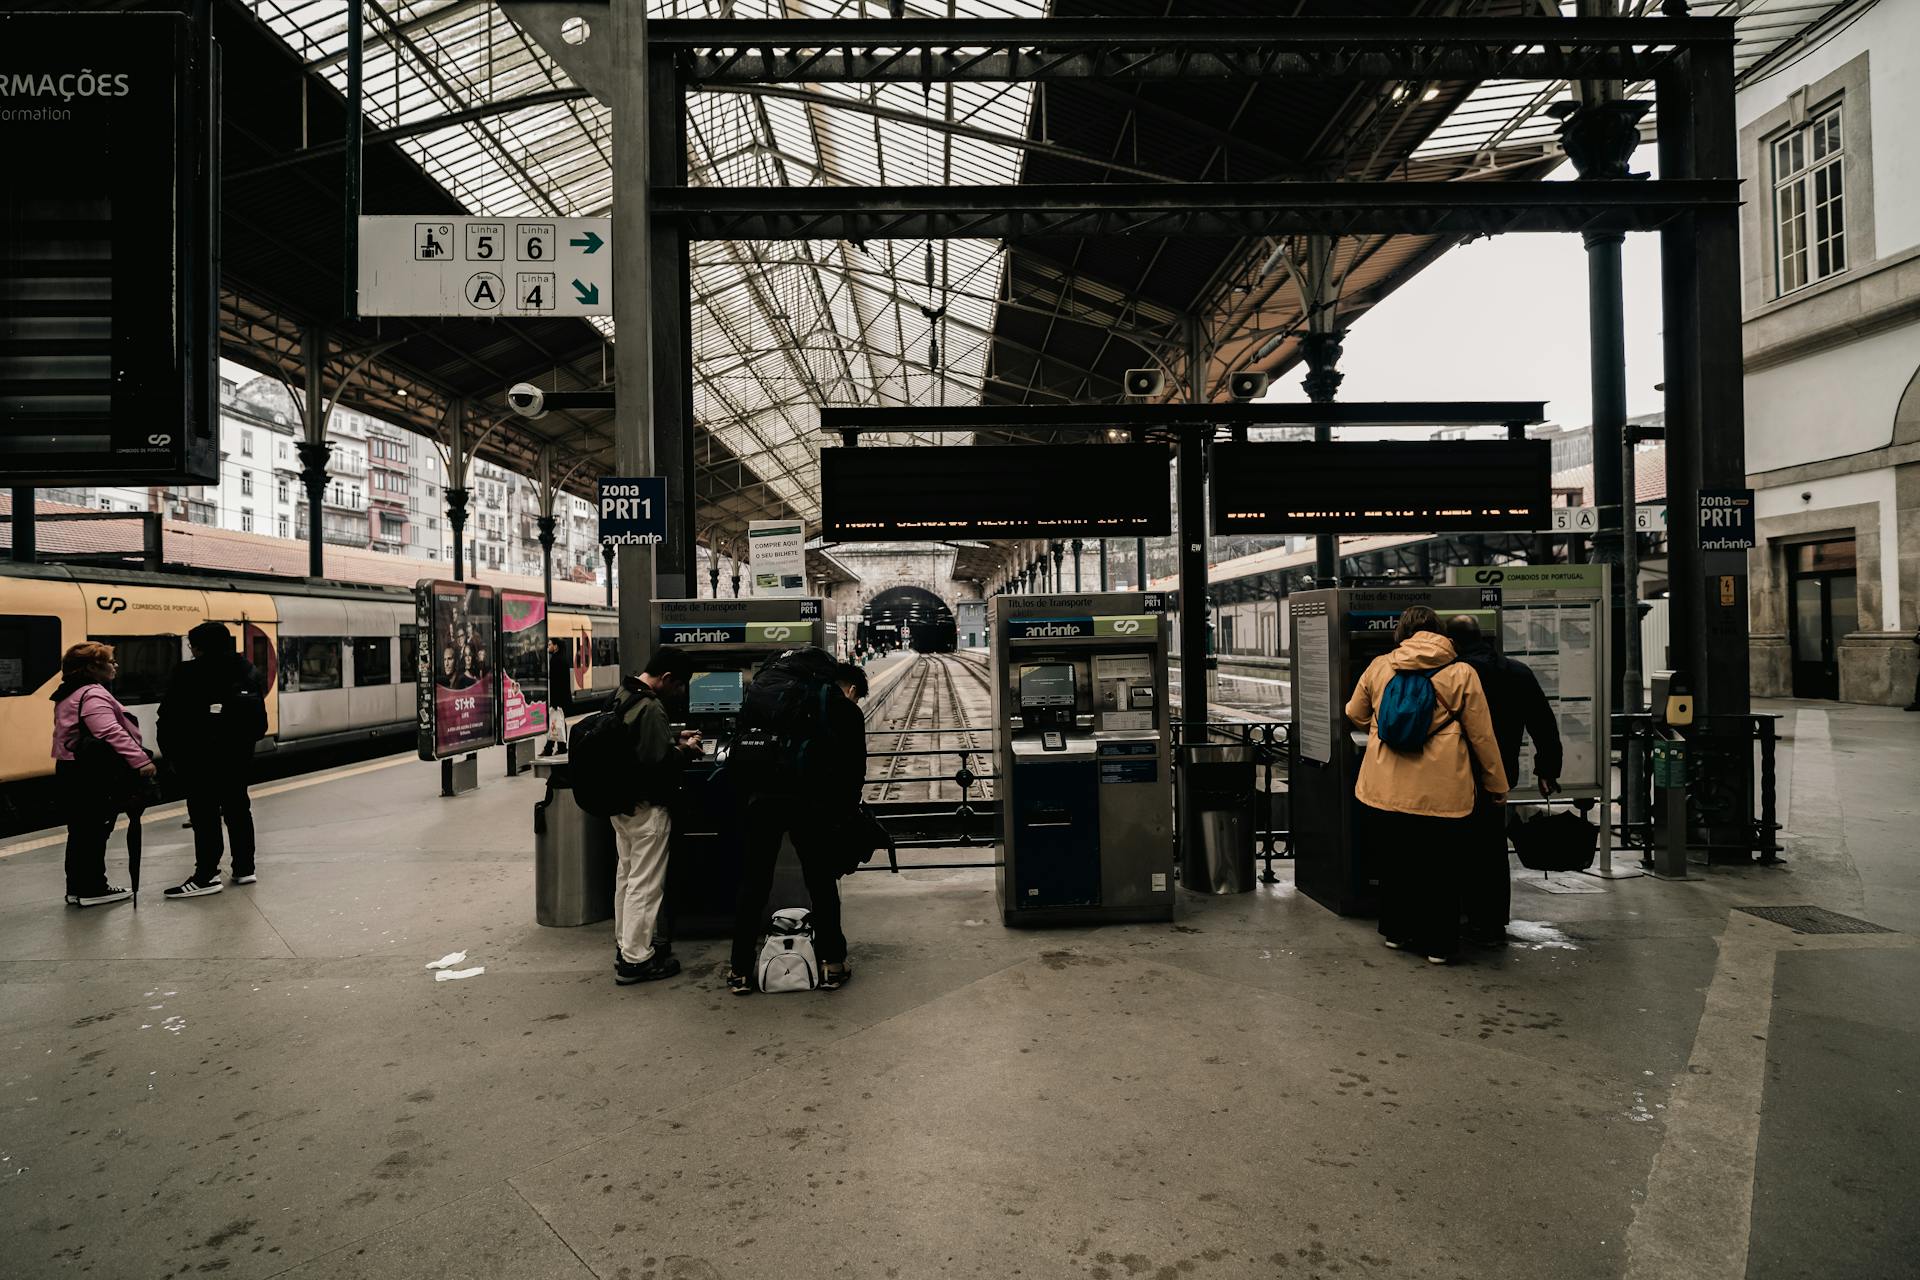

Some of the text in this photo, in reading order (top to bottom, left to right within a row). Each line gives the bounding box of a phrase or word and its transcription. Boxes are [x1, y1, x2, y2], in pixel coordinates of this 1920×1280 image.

[471, 226, 498, 234] Linha
[522, 226, 549, 235] Linha
[477, 236, 493, 259] 5
[527, 237, 543, 259] 6
[522, 275, 549, 283] Linha
[473, 280, 496, 303] A
[526, 285, 543, 308] 4
[601, 485, 640, 497] zona
[1700, 496, 1731, 507] zona
[602, 498, 651, 520] PRT1
[1558, 516, 1566, 528] 5
[1580, 514, 1591, 526] A
[1638, 515, 1646, 527] 6
[1700, 508, 1742, 527] PRT1
[602, 530, 663, 545] andante
[1702, 537, 1752, 550] andante
[754, 540, 798, 550] COMPRE AQUI
[775, 550, 799, 558] BILHETE
[1507, 572, 1584, 582] COMBOIOS DE PORTUGAL
[132, 603, 201, 613] COMBOIOS DE PORTUGAL
[703, 602, 747, 614] Transporte
[800, 606, 818, 614] PRT1
[1036, 598, 1048, 608] de
[1049, 598, 1093, 610] Transporte
[1367, 615, 1400, 630] anda
[673, 628, 731, 643] andante
[1025, 622, 1081, 637] andante
